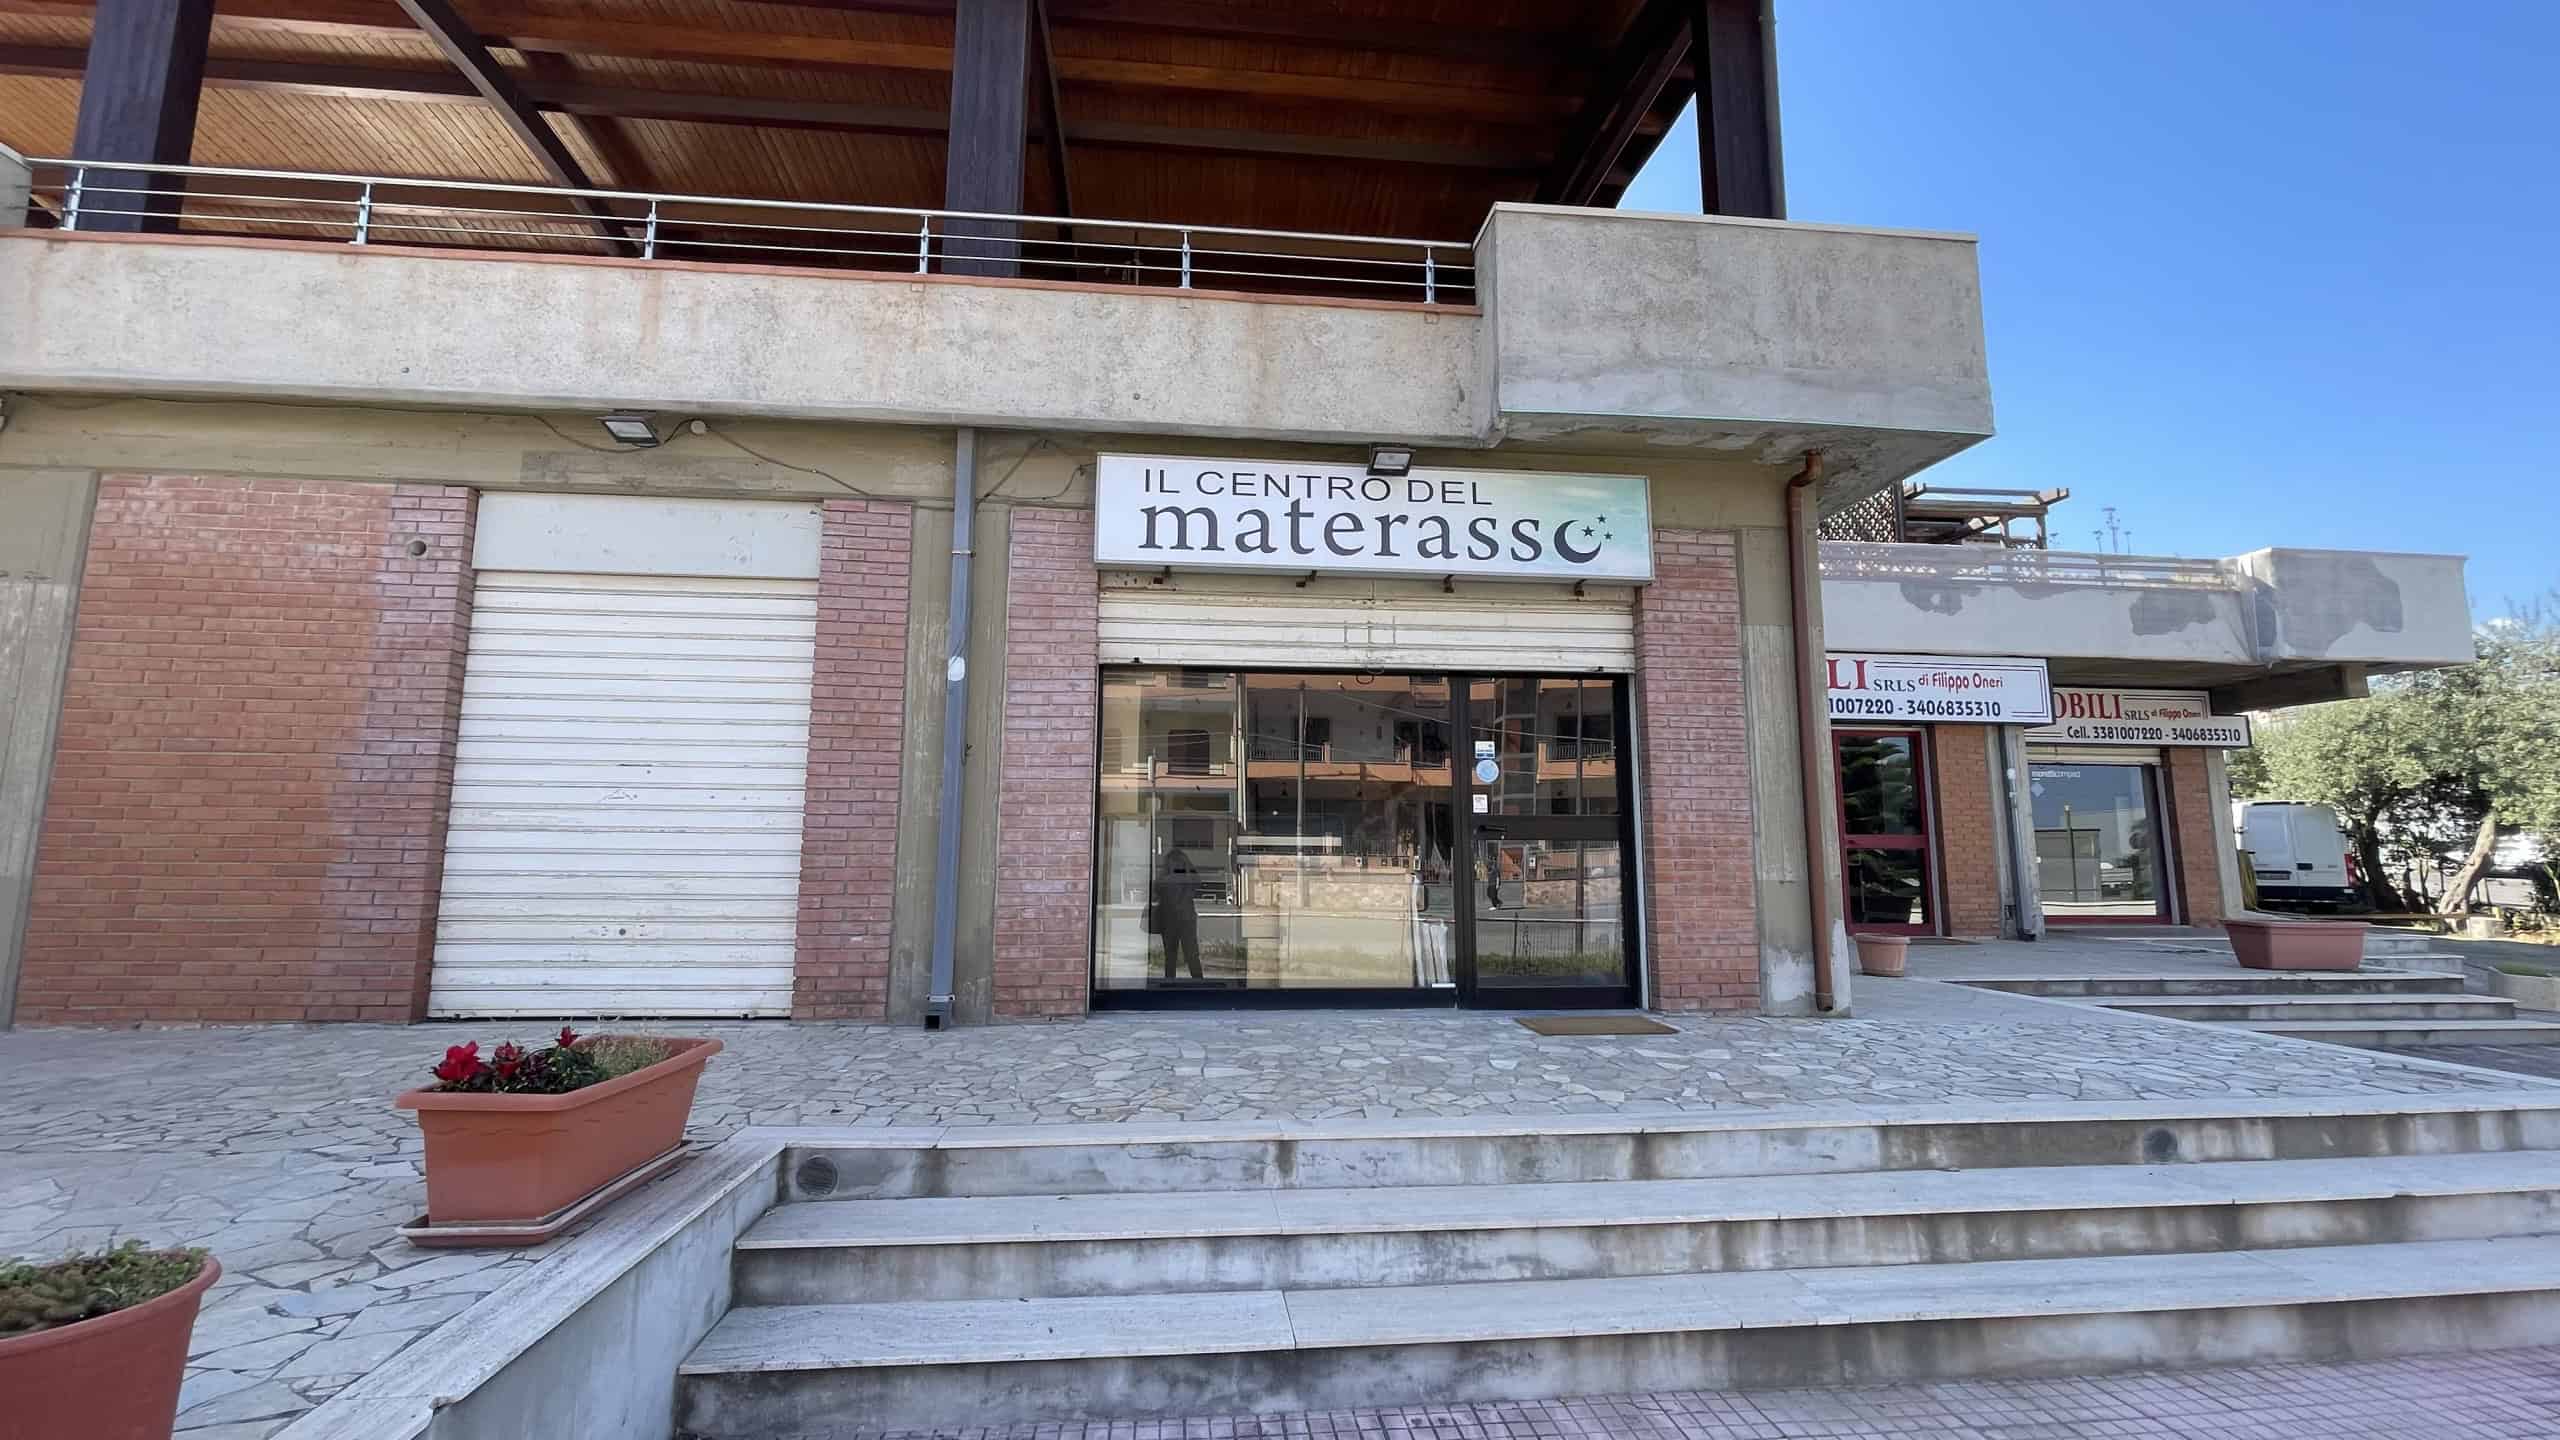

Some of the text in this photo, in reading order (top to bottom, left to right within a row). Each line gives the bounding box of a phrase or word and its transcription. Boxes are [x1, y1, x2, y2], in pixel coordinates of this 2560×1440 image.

[1143, 468, 1493, 505] IL CENTRO DEL
[1873, 679, 1916, 692] SRLS
[1918, 672, 1929, 686] di
[1931, 671, 1970, 694] Filippo
[1972, 672, 2004, 689] Oneri
[1906, 700, 2001, 717] 3406835310
[2124, 710, 2150, 721] SRLS
[2067, 726, 2091, 739] Cell.
[2093, 726, 2163, 741] 3381007220
[2171, 728, 2241, 742] 3406835310
